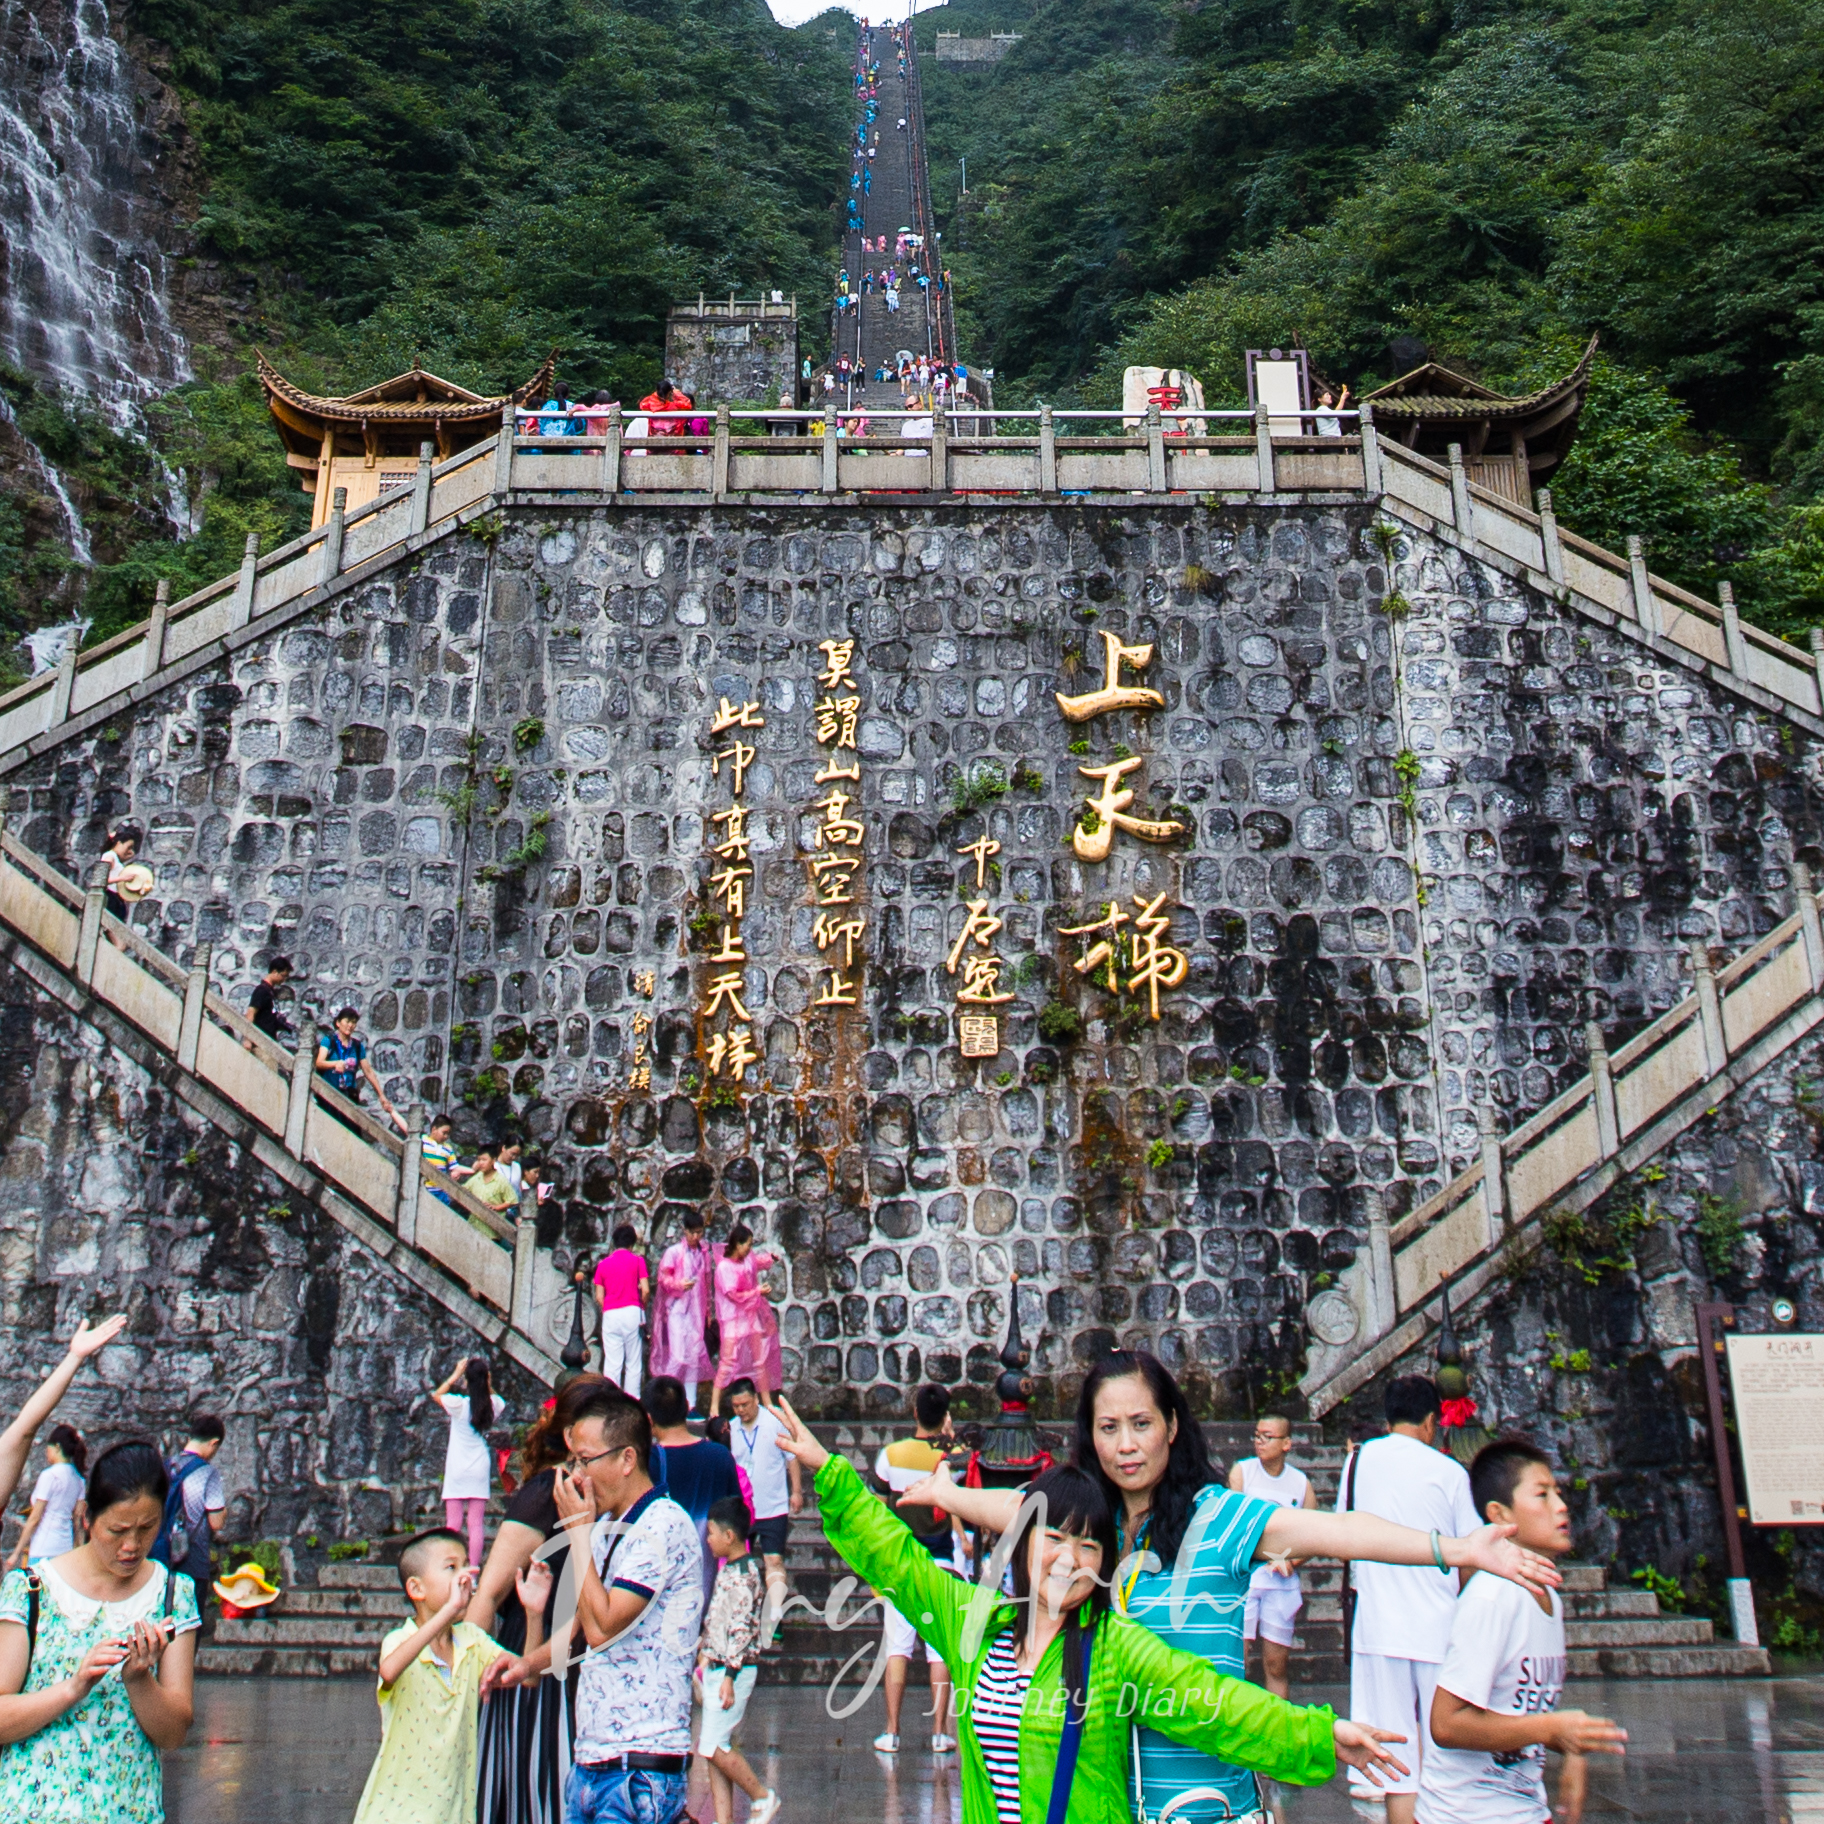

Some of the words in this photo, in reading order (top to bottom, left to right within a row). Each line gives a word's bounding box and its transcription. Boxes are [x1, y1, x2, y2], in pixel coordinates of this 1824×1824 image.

[1056, 630, 1189, 1022] 上天梯
[634, 969, 656, 997] 清
